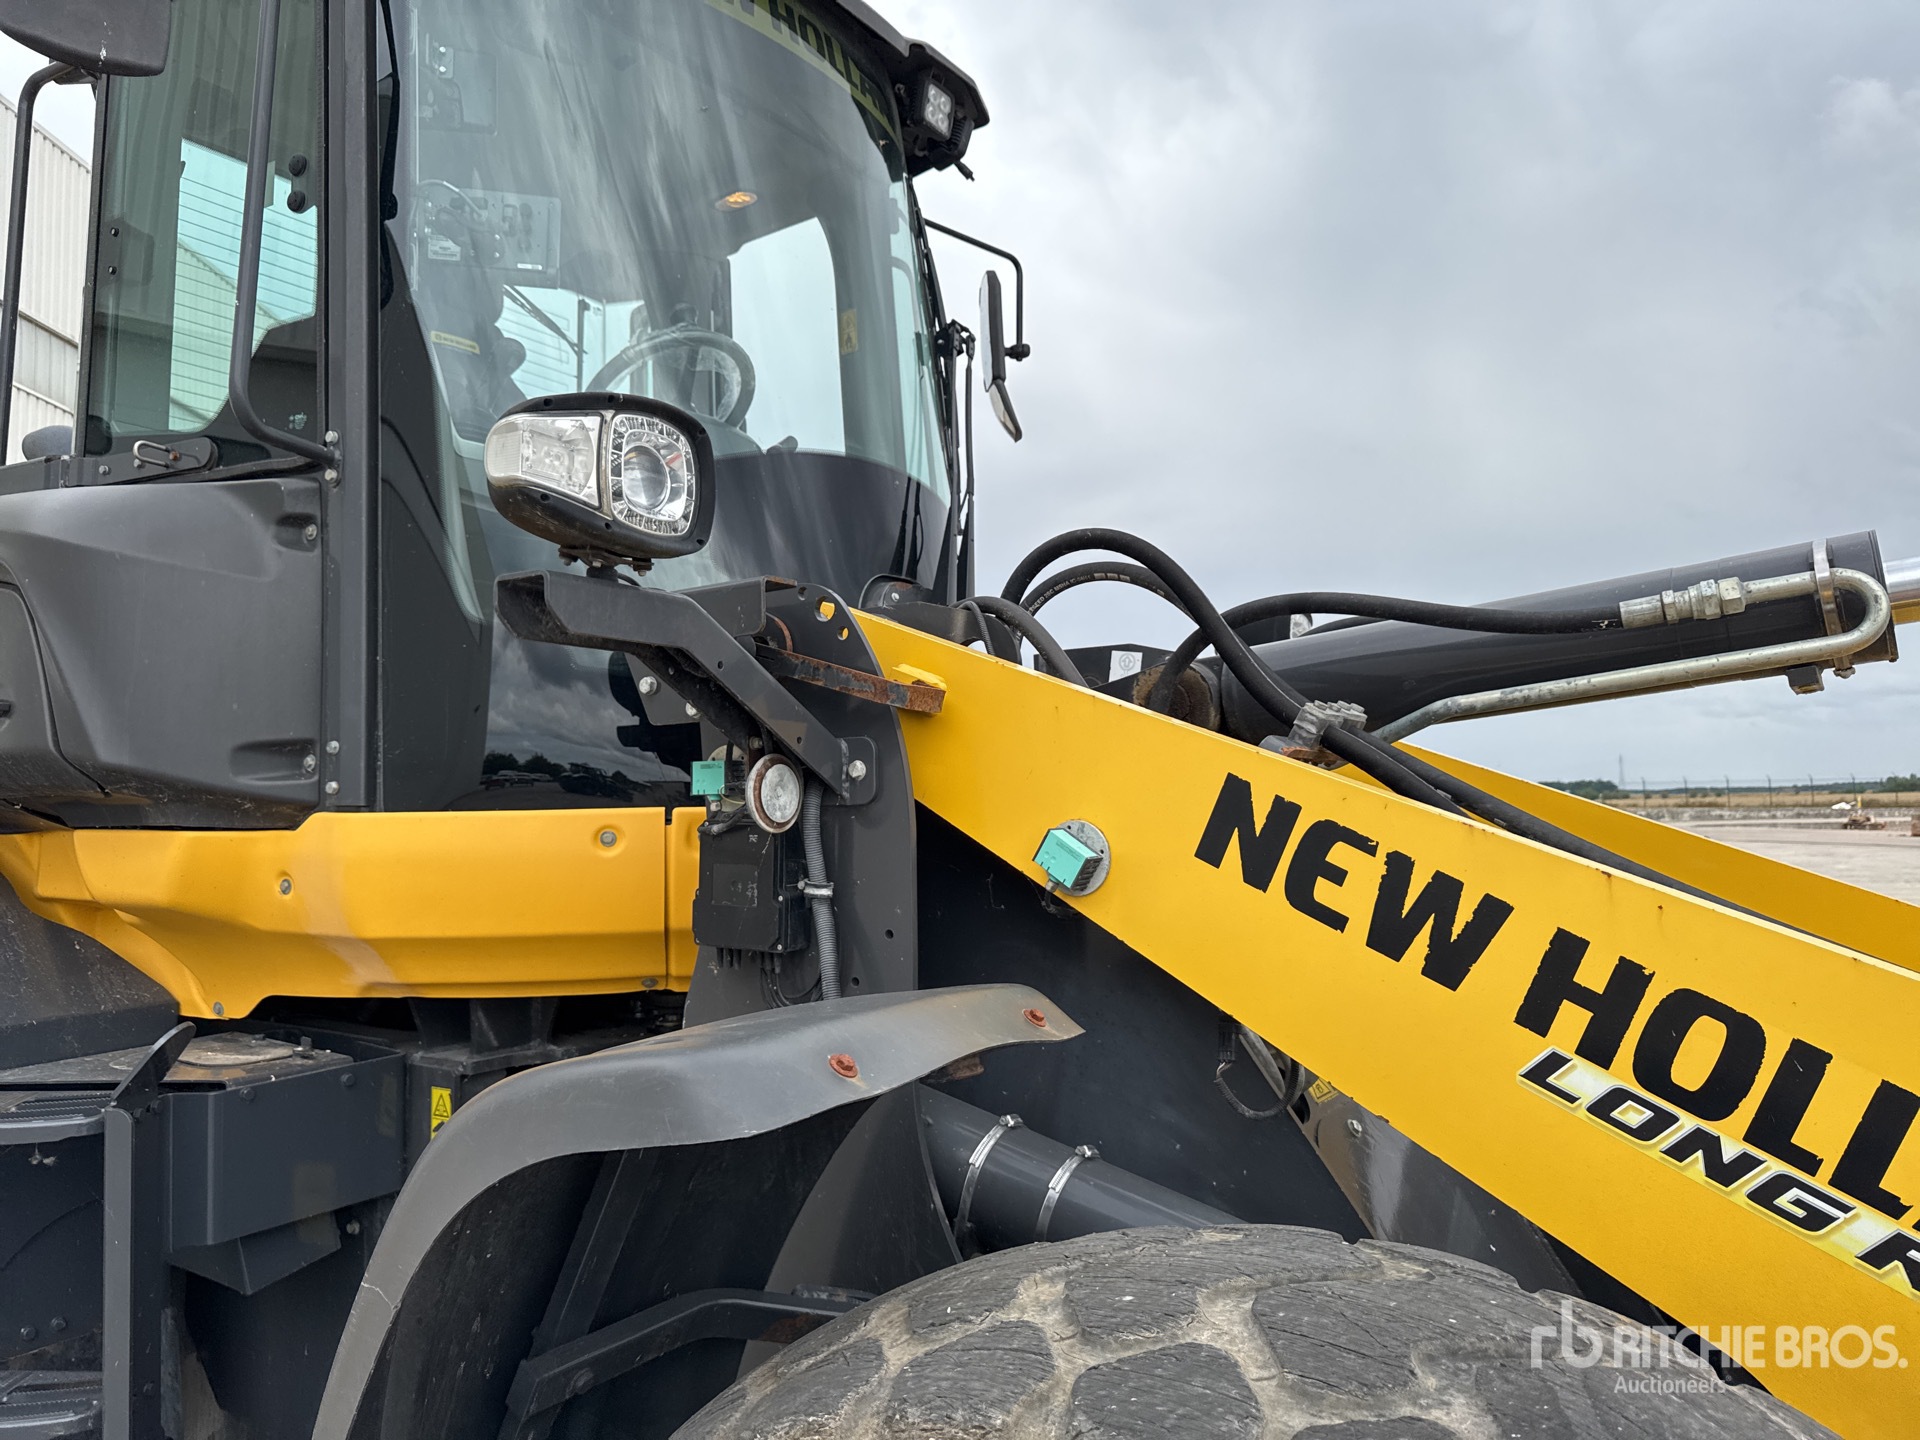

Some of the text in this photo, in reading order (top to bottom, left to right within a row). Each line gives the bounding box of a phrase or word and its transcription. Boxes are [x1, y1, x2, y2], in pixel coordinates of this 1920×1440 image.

[1194, 772, 1920, 1232] NEW HOLL
[1518, 1047, 1857, 1234] LONG
